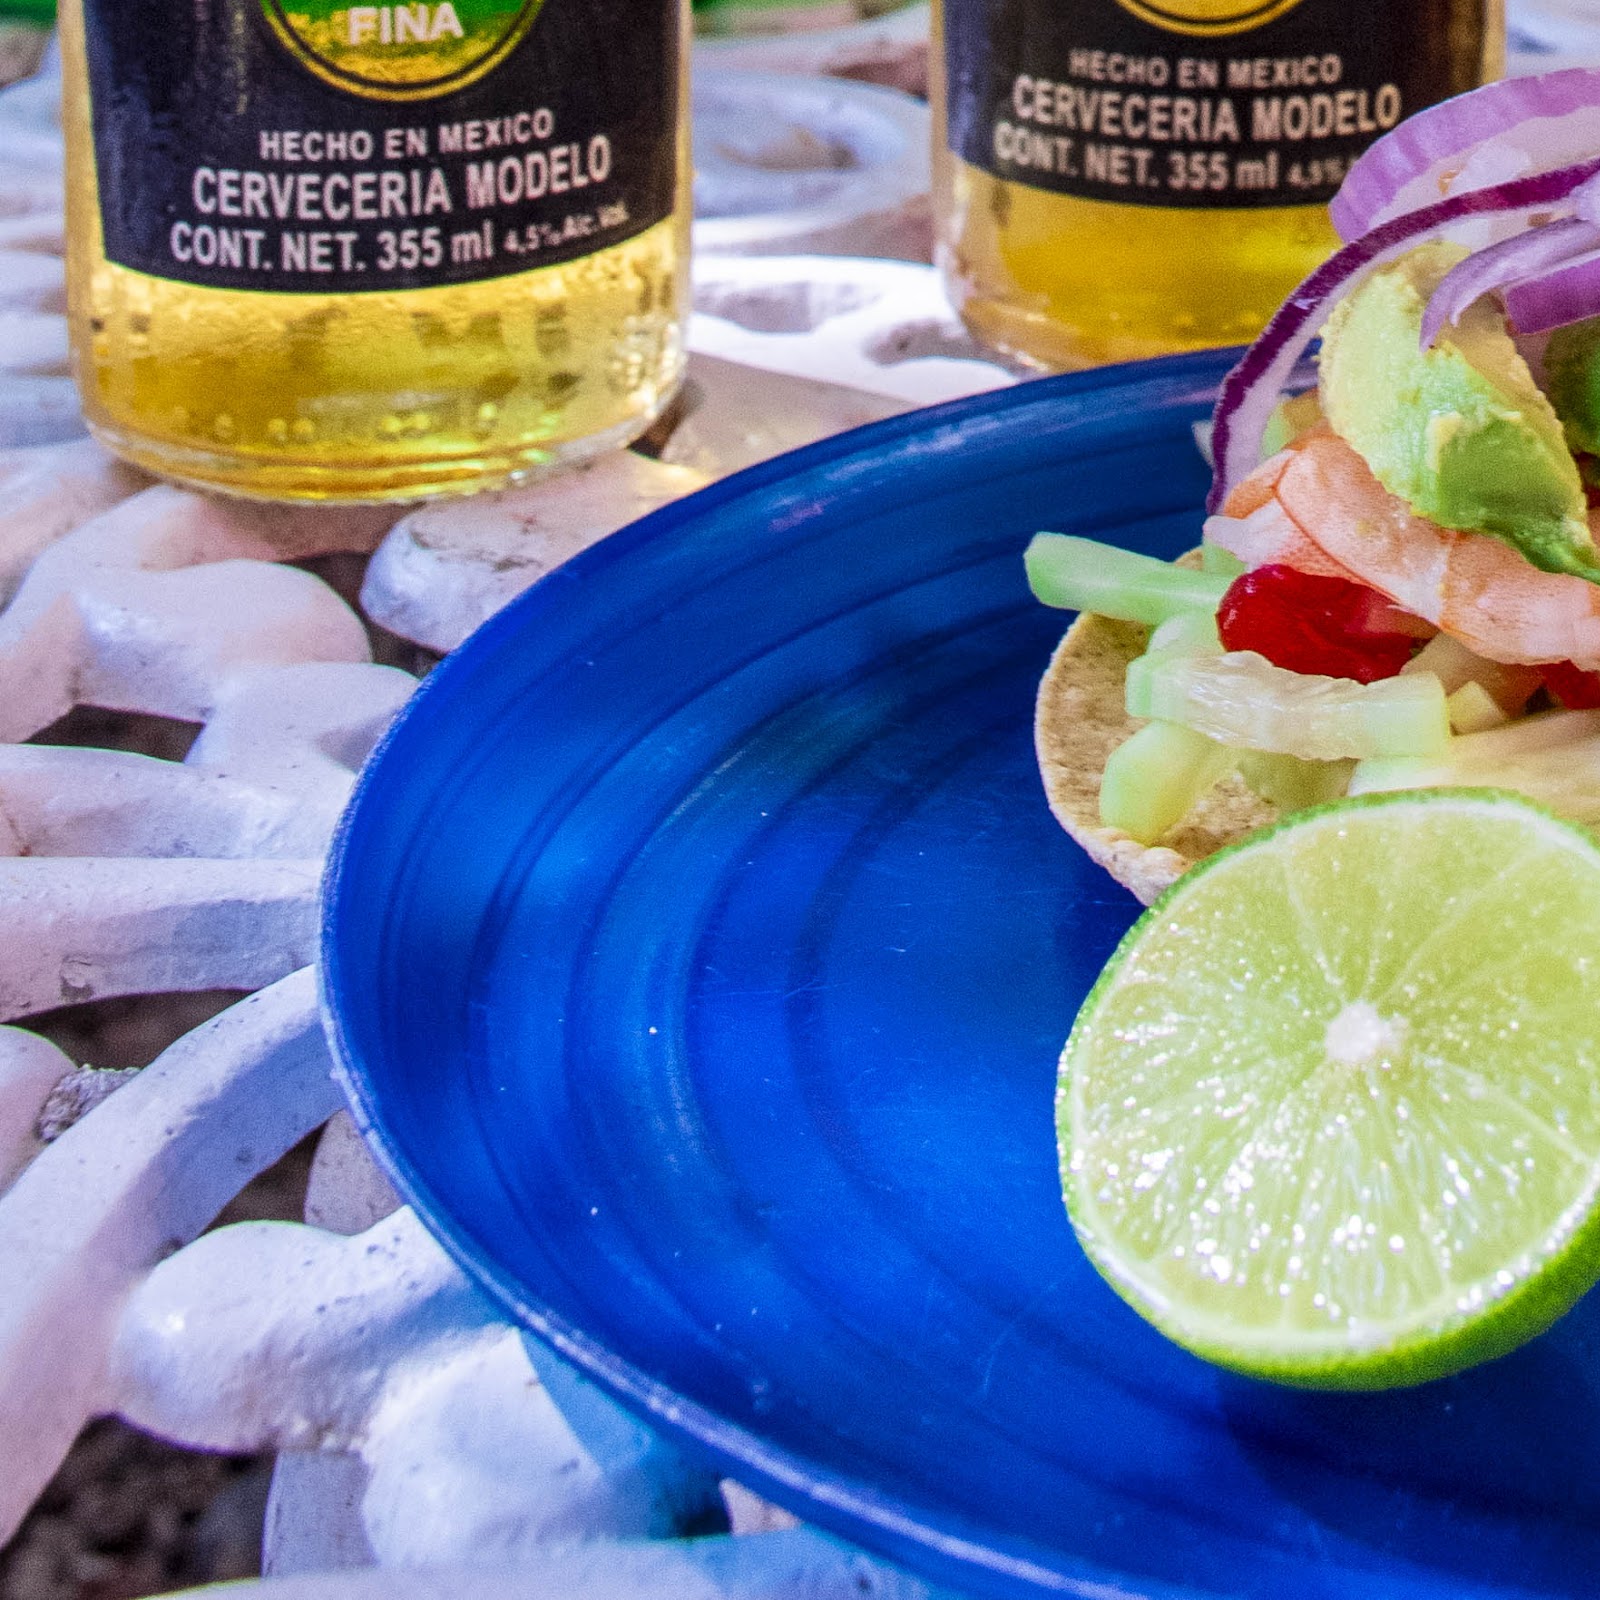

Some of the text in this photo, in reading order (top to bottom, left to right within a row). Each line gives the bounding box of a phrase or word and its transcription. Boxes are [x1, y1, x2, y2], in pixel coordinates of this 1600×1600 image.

[348, 2, 465, 45] FINA
[1069, 49, 1344, 89] HECHO EN MEXICO
[259, 107, 554, 162] HECHO EN MEXICO
[1013, 73, 1400, 142] CERVECERIA MODELO
[191, 134, 612, 221] CERVECERIA MODELO
[995, 120, 1078, 178] CONT.
[1084, 144, 1160, 188] NET.
[1168, 151, 1229, 191] 355
[1235, 149, 1279, 189] ml
[170, 220, 273, 272] CONT.
[282, 231, 366, 272] NET.
[377, 227, 442, 271] 355
[451, 221, 494, 263] ml
